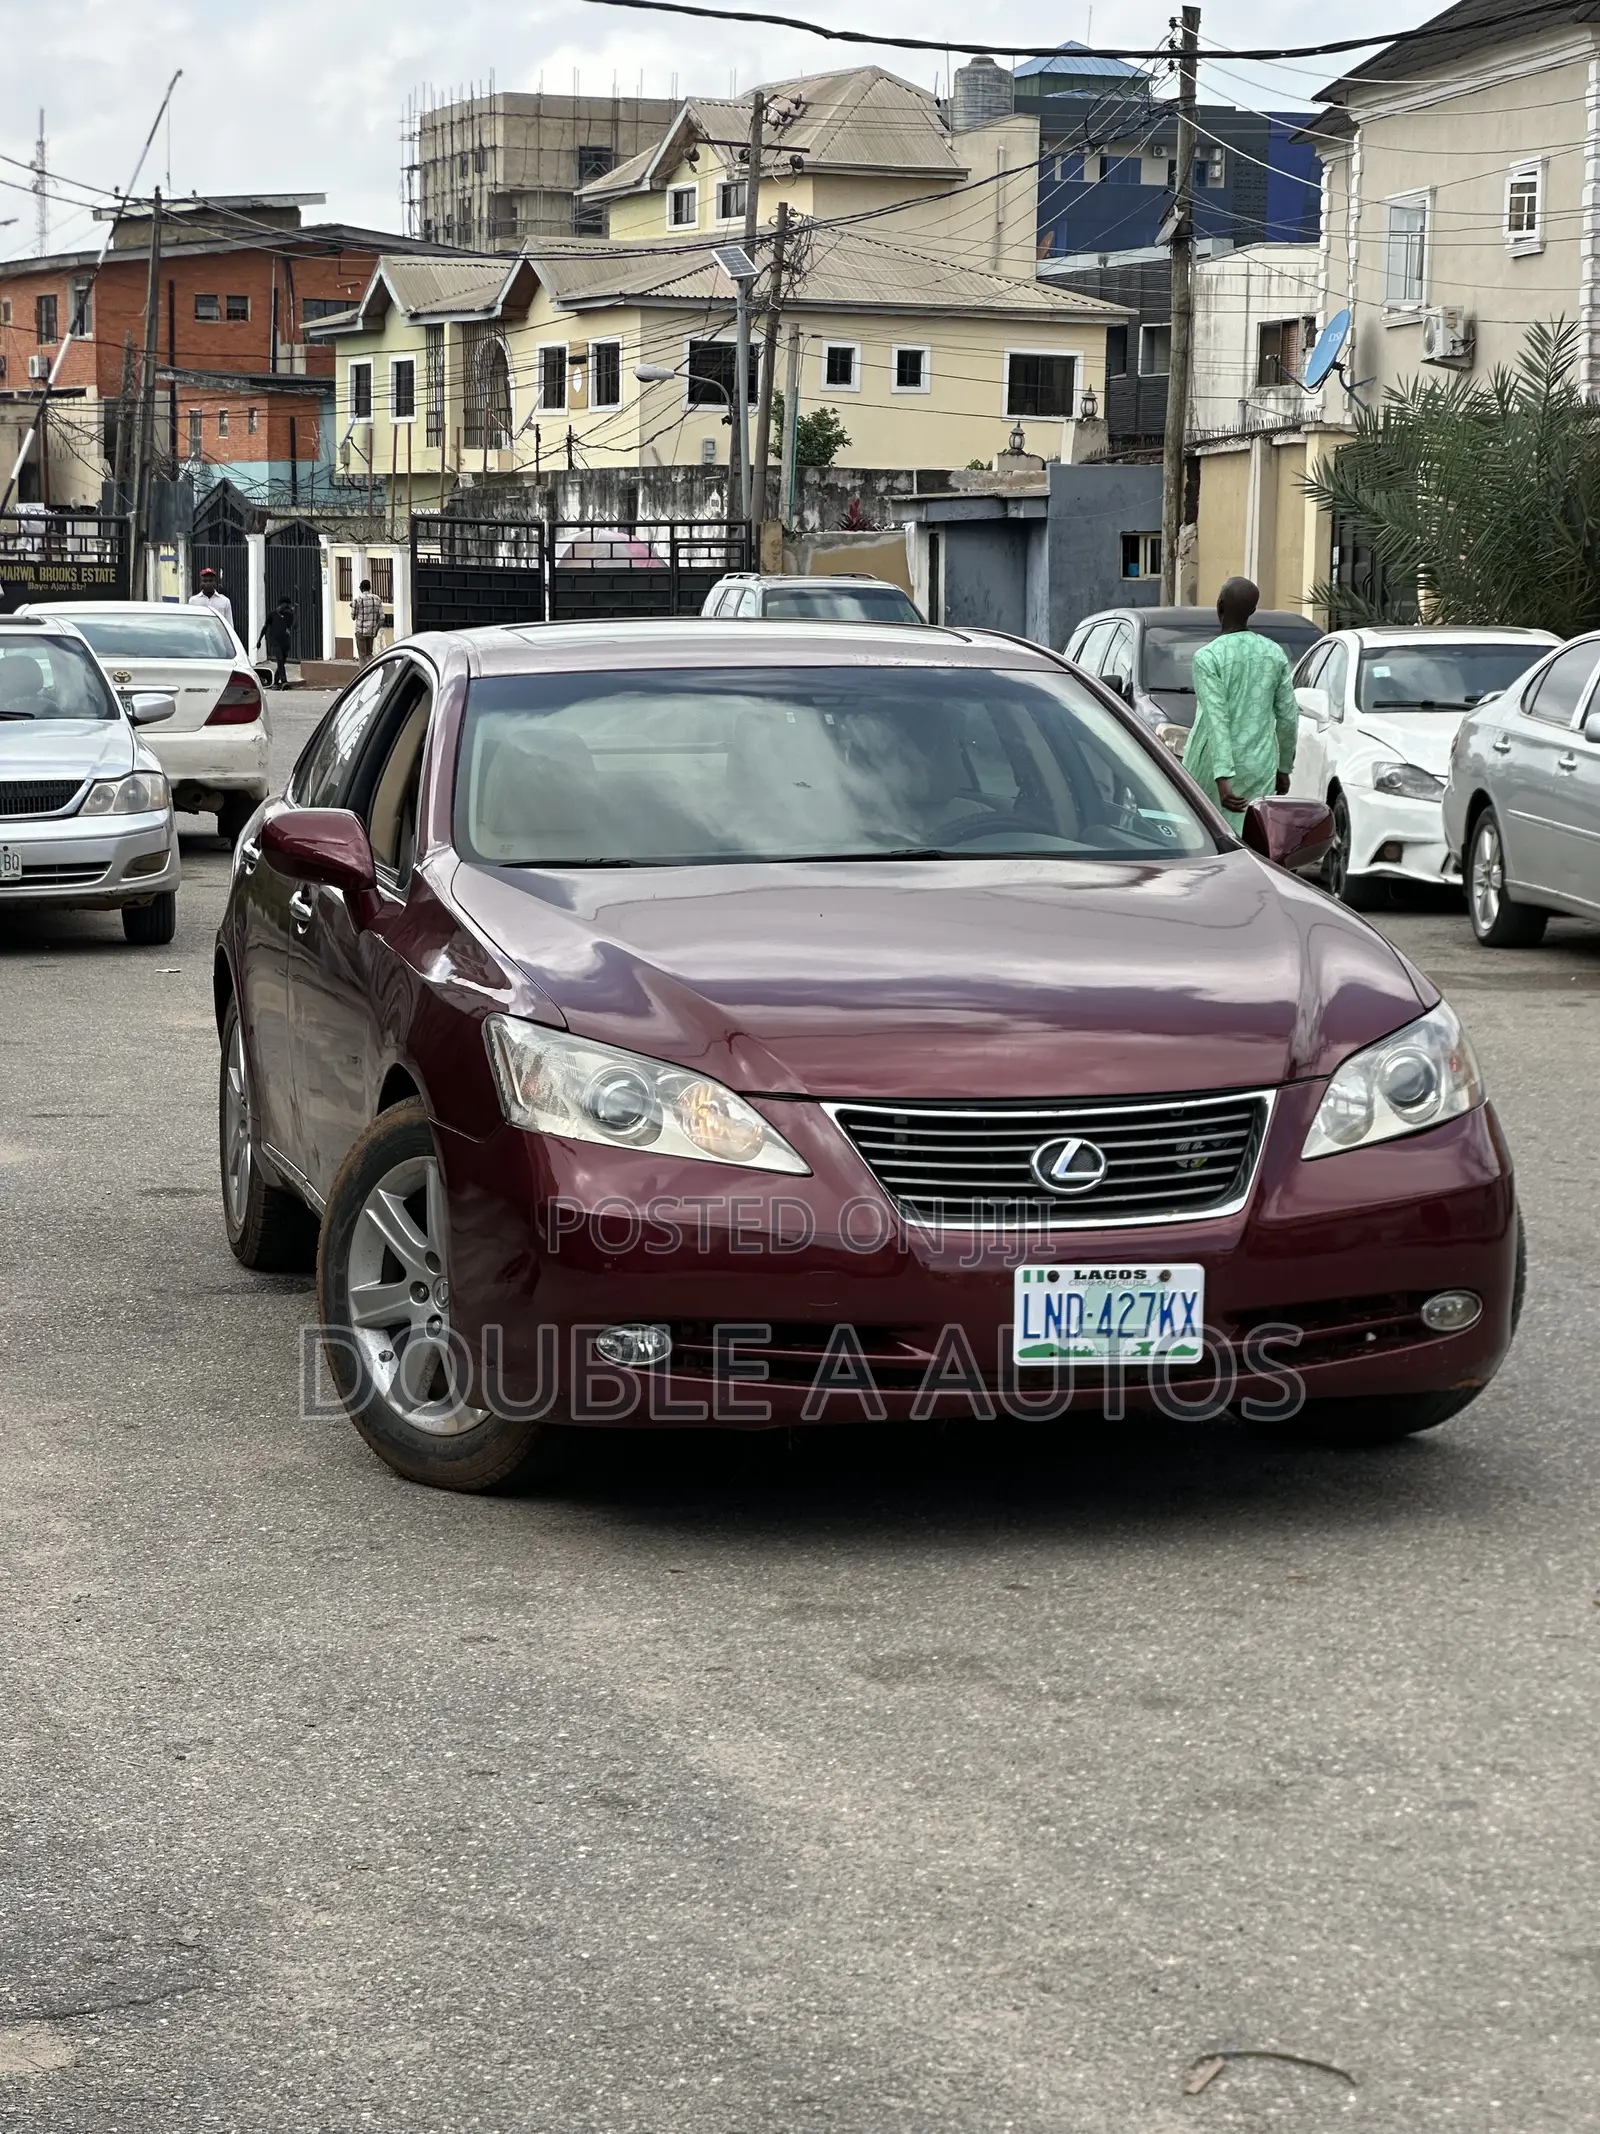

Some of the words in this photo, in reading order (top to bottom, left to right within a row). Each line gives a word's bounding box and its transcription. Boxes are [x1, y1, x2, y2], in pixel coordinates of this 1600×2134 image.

[0, 566, 35, 581] MARWA
[40, 567, 77, 582] BROOKS
[81, 568, 116, 583] ESTATE
[1074, 1269, 1148, 1280] LAGOS
